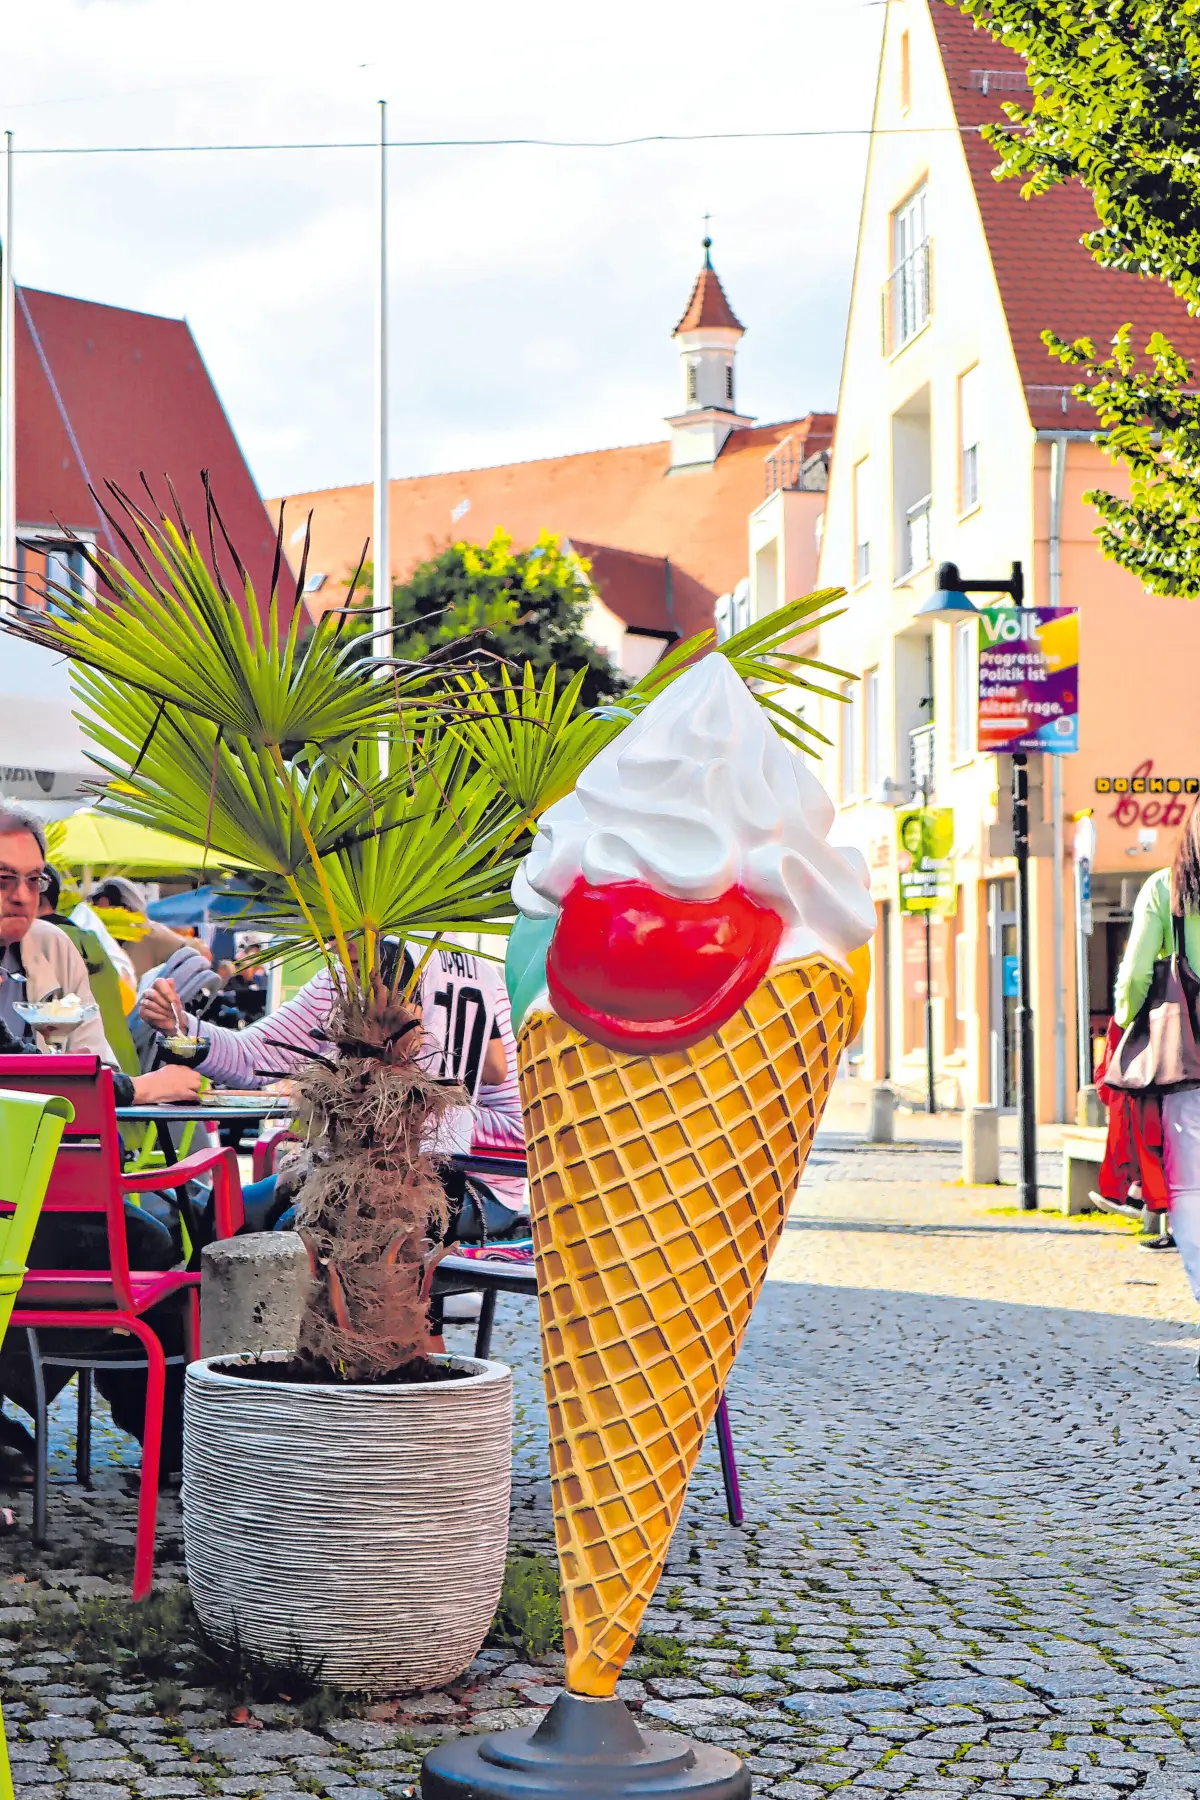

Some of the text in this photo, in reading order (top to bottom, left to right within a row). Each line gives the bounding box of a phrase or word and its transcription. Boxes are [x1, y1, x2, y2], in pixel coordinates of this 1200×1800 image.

[981, 612, 1042, 641] Volt
[979, 651, 1061, 667] Progressive
[979, 667, 1047, 681] Politik ist
[979, 684, 1017, 698] keine
[434, 982, 486, 1095] 10
